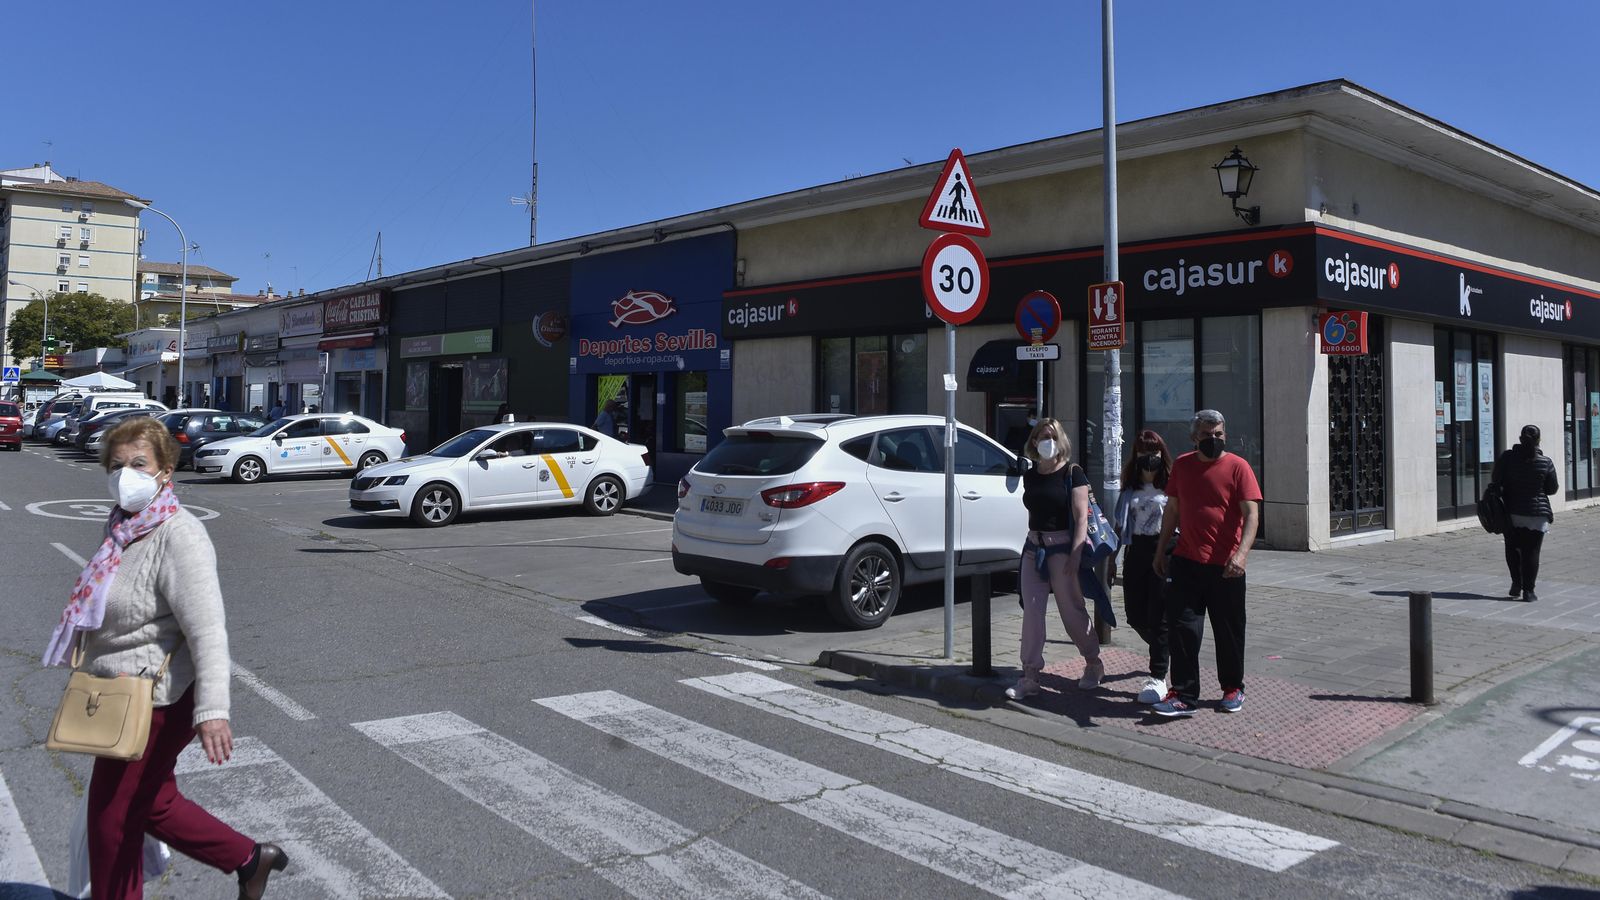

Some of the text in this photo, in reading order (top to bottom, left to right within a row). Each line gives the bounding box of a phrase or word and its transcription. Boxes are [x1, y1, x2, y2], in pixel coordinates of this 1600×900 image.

[939, 264, 974, 294] 30
[1143, 258, 1263, 296] cajasur
[1325, 252, 1387, 292] cajasur
[349, 293, 380, 309] CAFE BAR
[349, 308, 380, 322] CRISTINA
[728, 302, 785, 328] cajasur
[1530, 294, 1565, 324] cajasur
[1091, 326, 1120, 335] HIDRANTE
[1093, 333, 1118, 341] CONTRA
[579, 328, 717, 358] Deportes Sevilla
[1090, 339, 1121, 347] INCENDIOS
[604, 354, 680, 367] deportiva-ropa.com
[976, 365, 999, 374] cajasur
[705, 500, 723, 512] 4033
[725, 502, 741, 514] JDG
